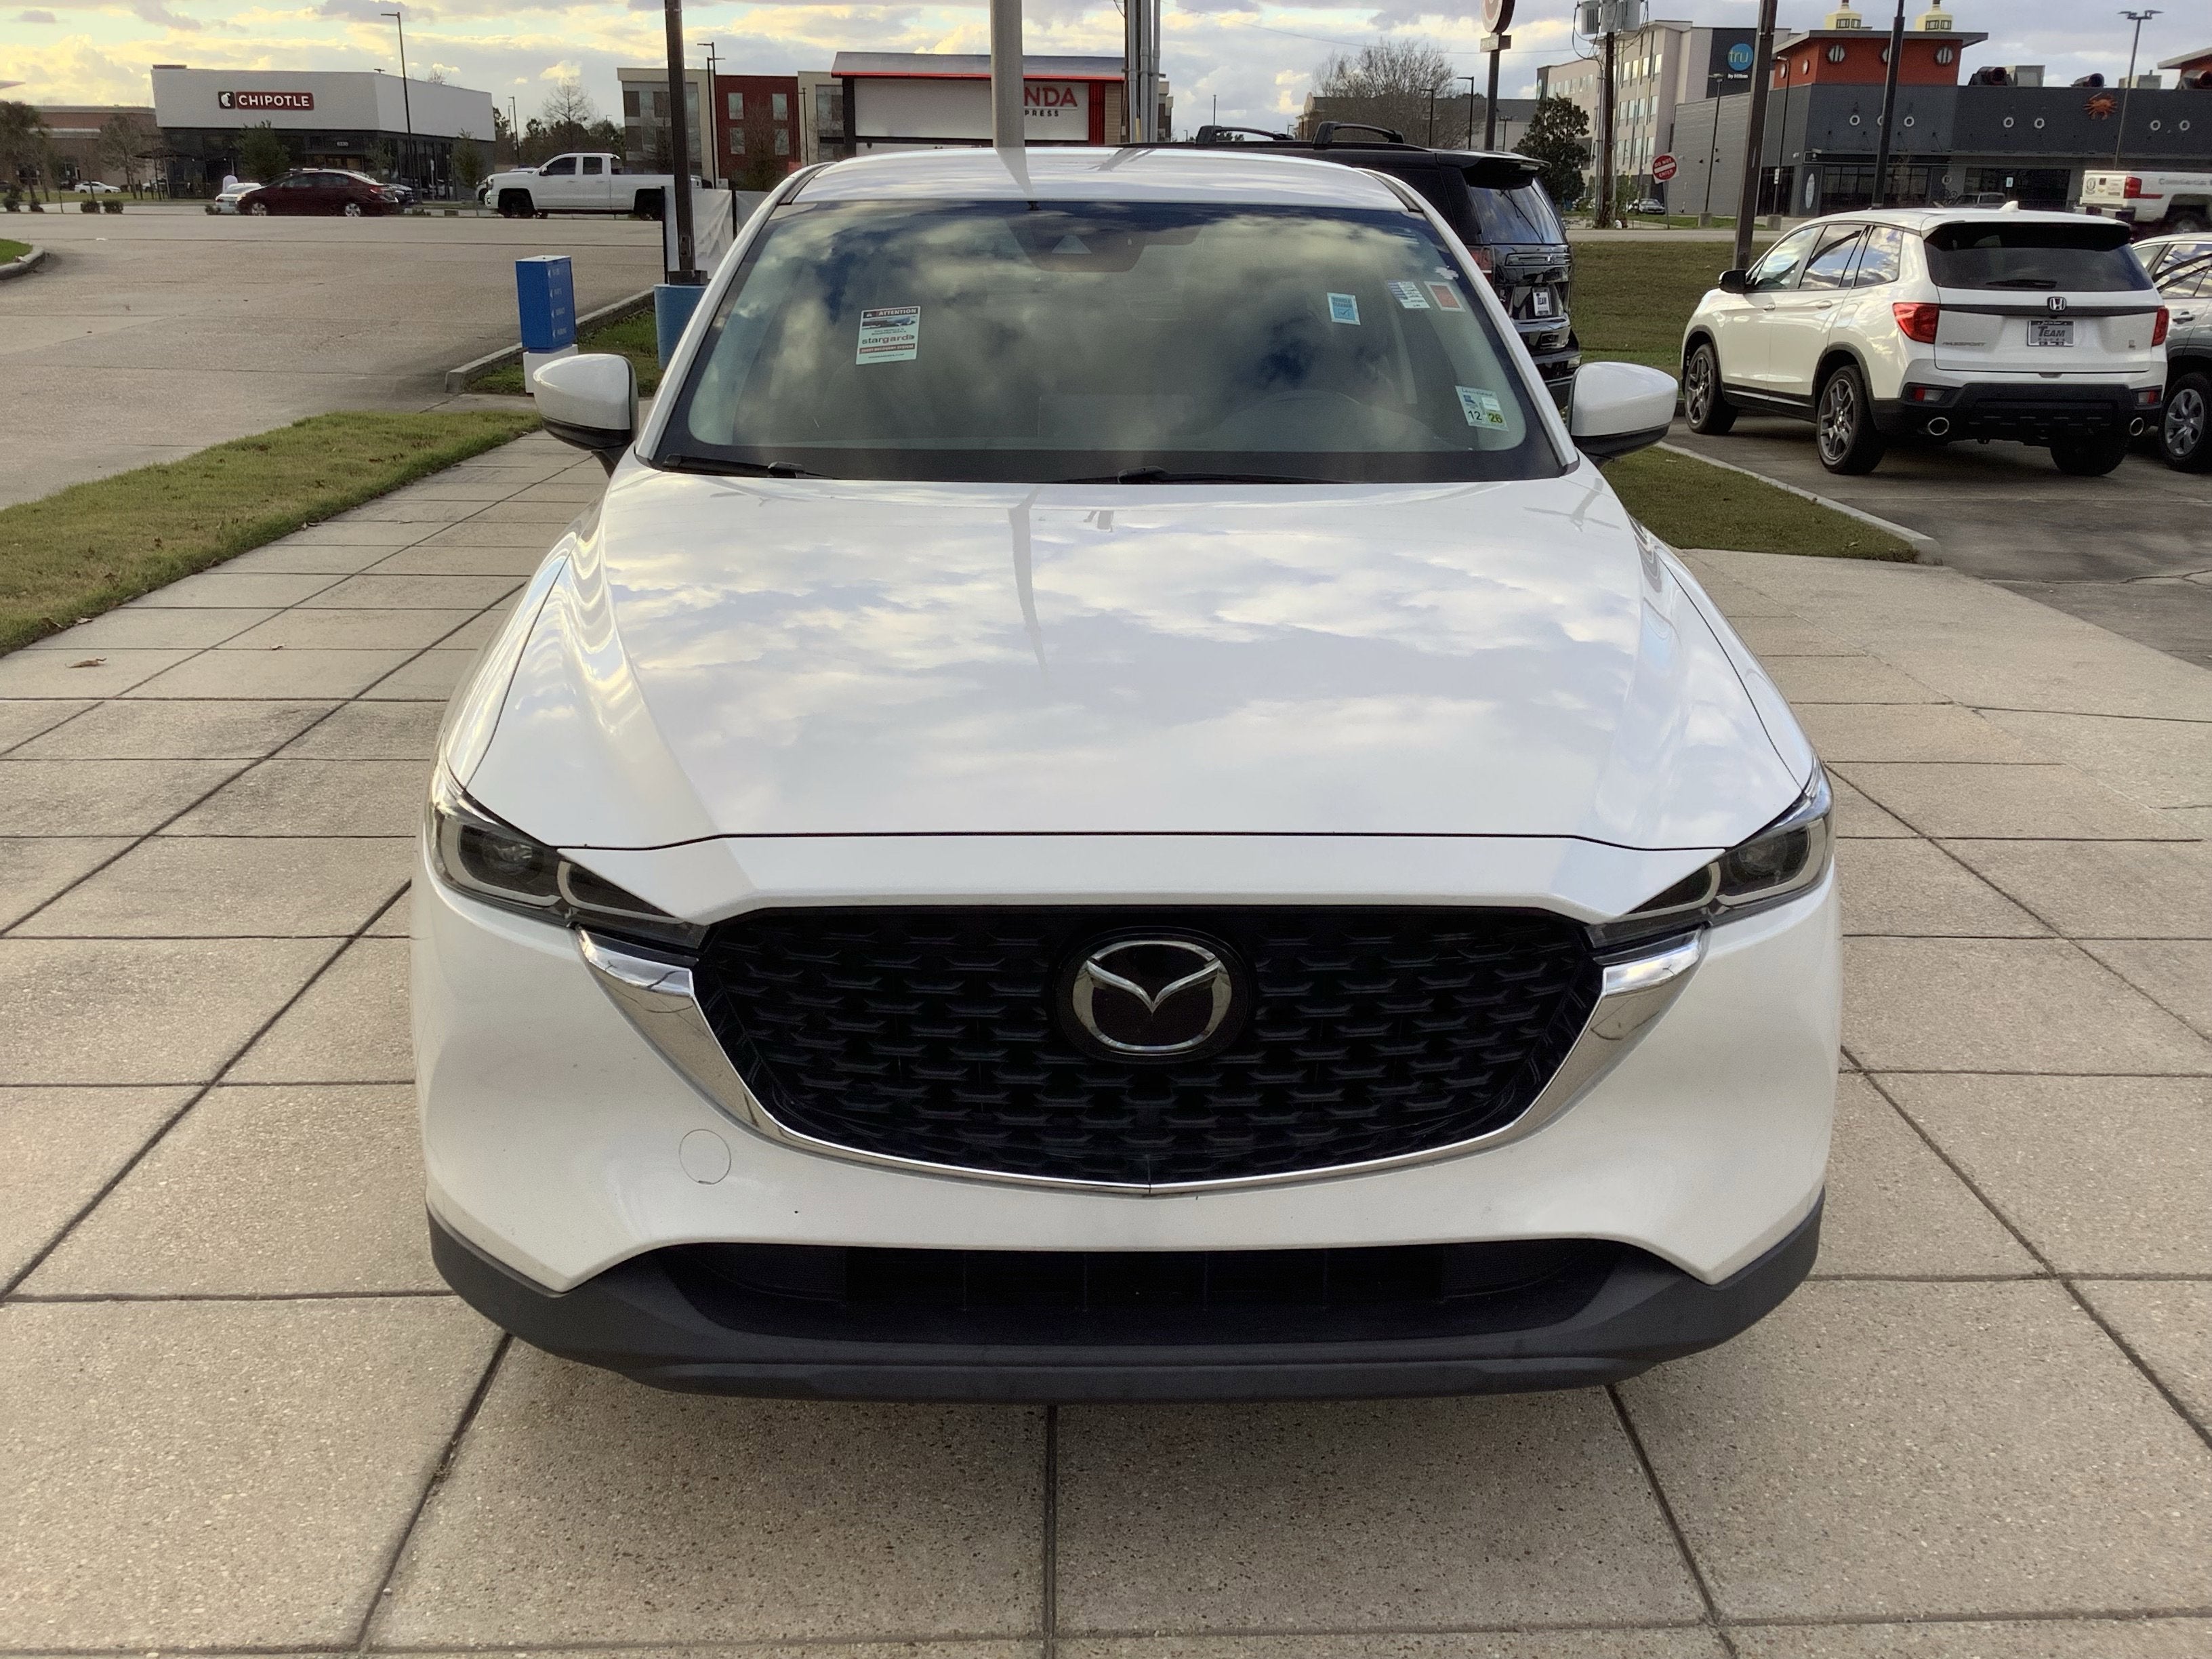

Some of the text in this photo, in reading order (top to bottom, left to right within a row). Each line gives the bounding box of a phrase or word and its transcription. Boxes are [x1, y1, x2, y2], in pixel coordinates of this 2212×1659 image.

[1729, 49, 1748, 63] tru
[238, 94, 310, 106] CHIPOTLE
[1024, 87, 1078, 106] NDA
[2038, 326, 2066, 337] TEAM
[1468, 410, 1483, 420] 12
[1488, 413, 1502, 423] 26
